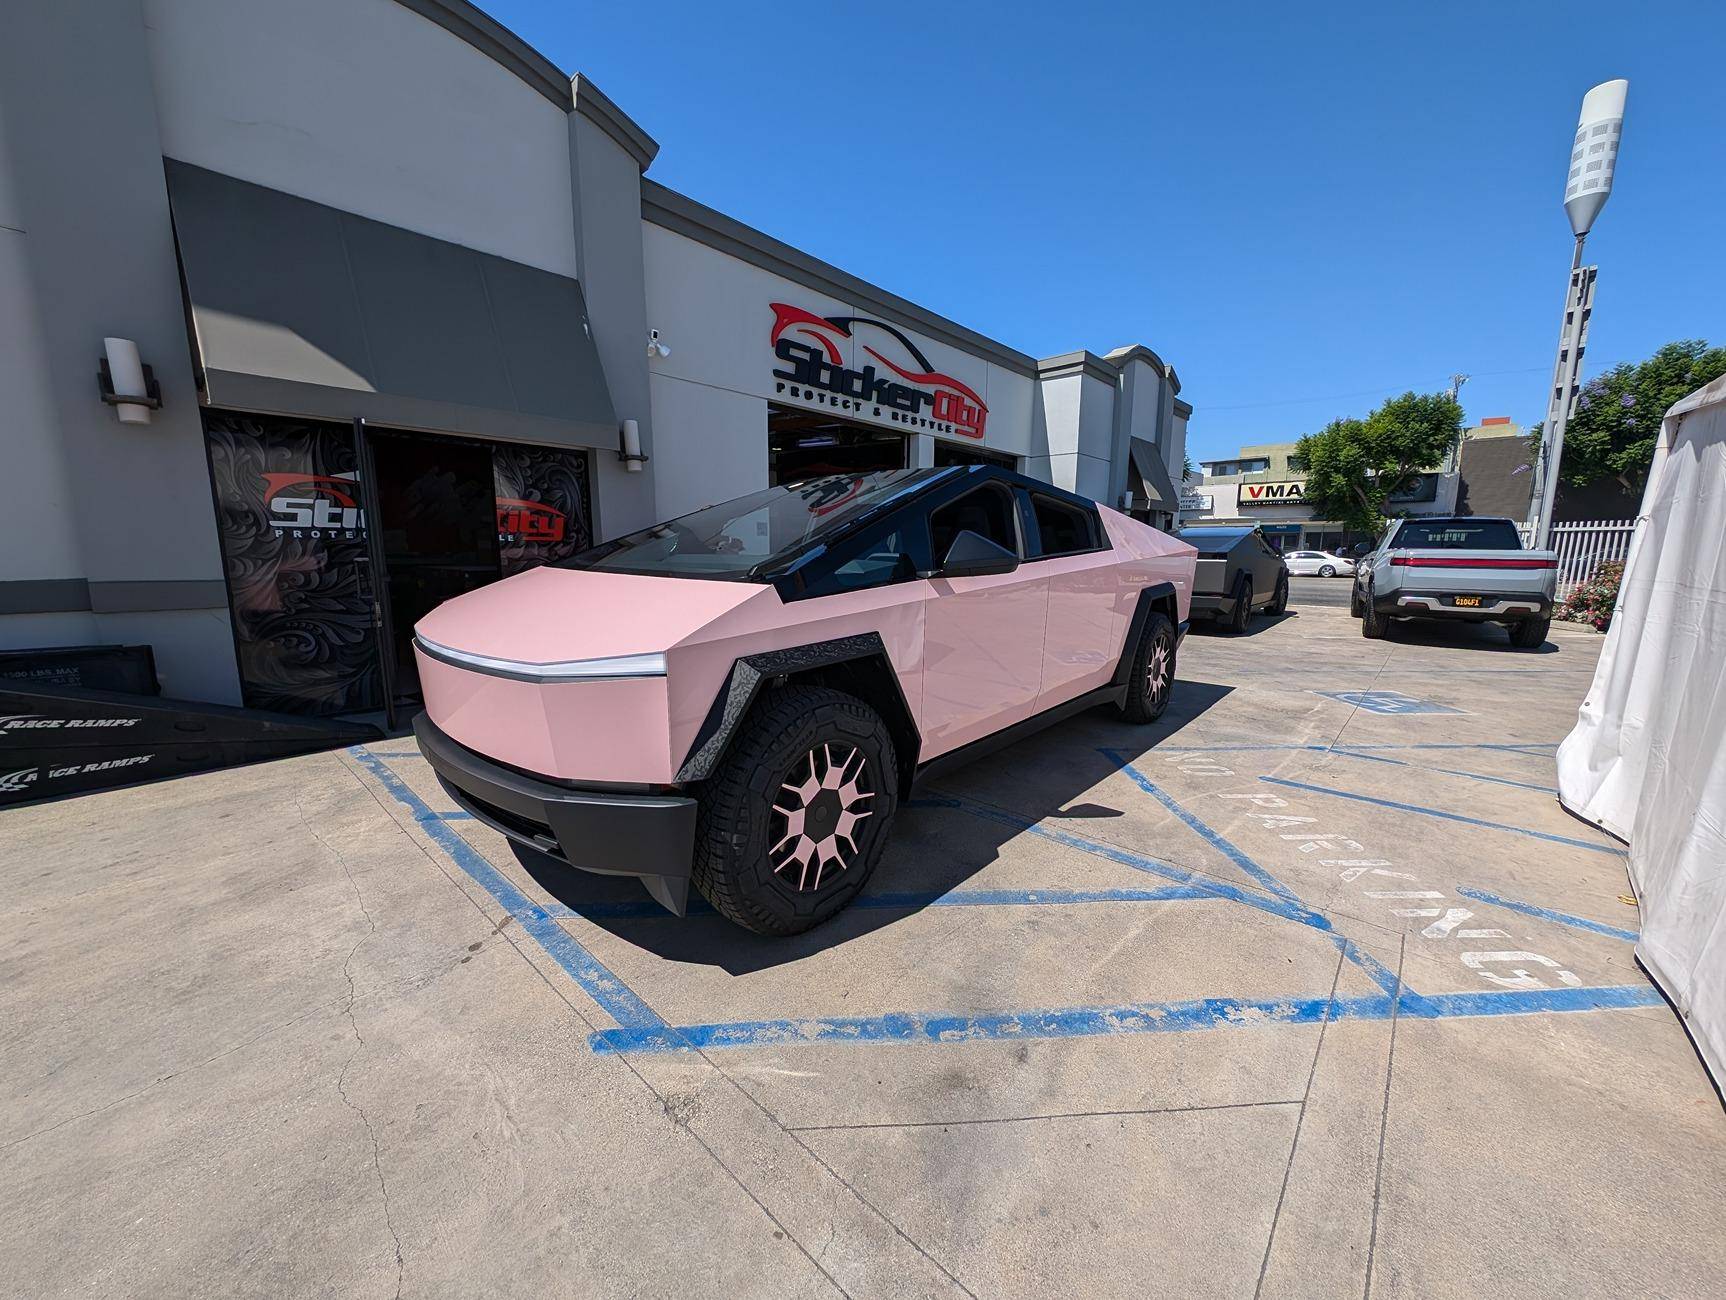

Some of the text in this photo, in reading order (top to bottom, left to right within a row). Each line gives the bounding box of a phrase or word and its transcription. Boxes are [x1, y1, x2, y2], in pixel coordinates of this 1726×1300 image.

[776, 382, 952, 433] PROTECT & RESTYLE
[55, 667, 79, 675] MAX
[4, 719, 139, 729] RACE RAMPS
[24, 755, 153, 782] RCE RAMPS
[1218, 793, 1582, 990] PARKING
